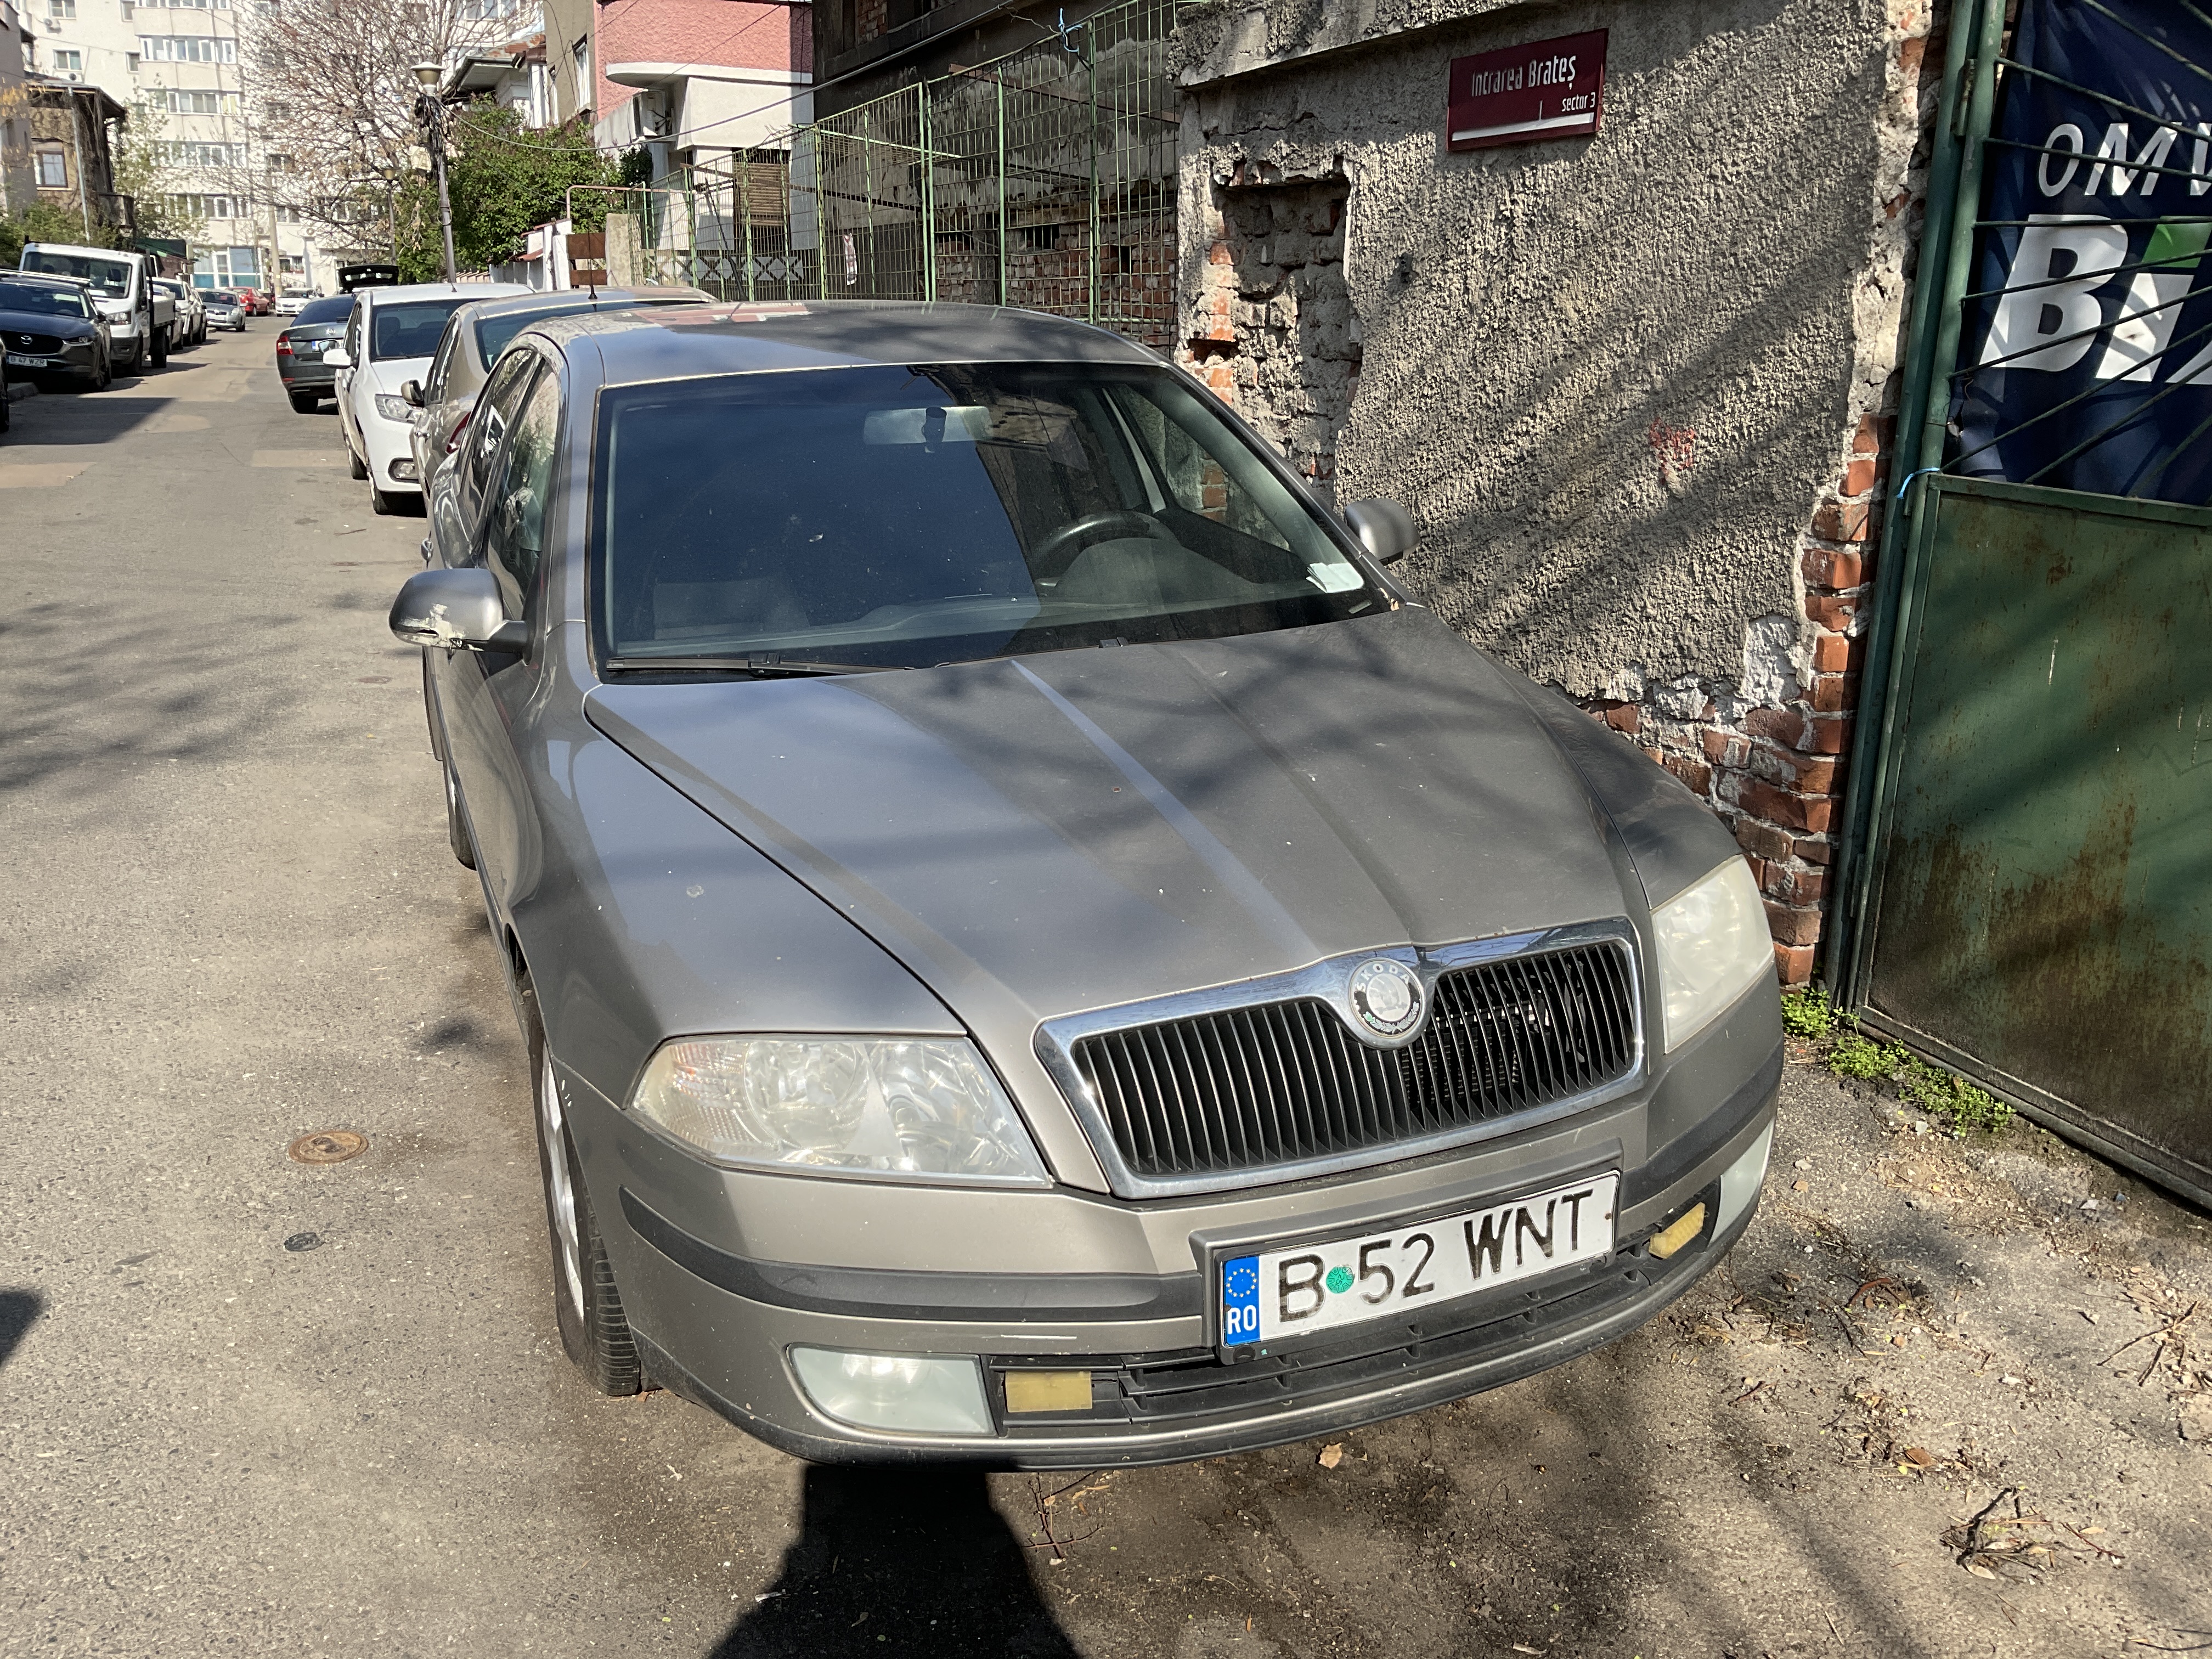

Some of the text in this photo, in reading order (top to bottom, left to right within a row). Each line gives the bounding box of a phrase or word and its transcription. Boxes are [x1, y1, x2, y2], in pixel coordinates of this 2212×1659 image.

[1472, 55, 1576, 97] Intrarea Brateș
[1561, 92, 1596, 112] sector 3
[1279, 1188, 1594, 1322] B 52 WNT
[1228, 1305, 1256, 1334] RO
